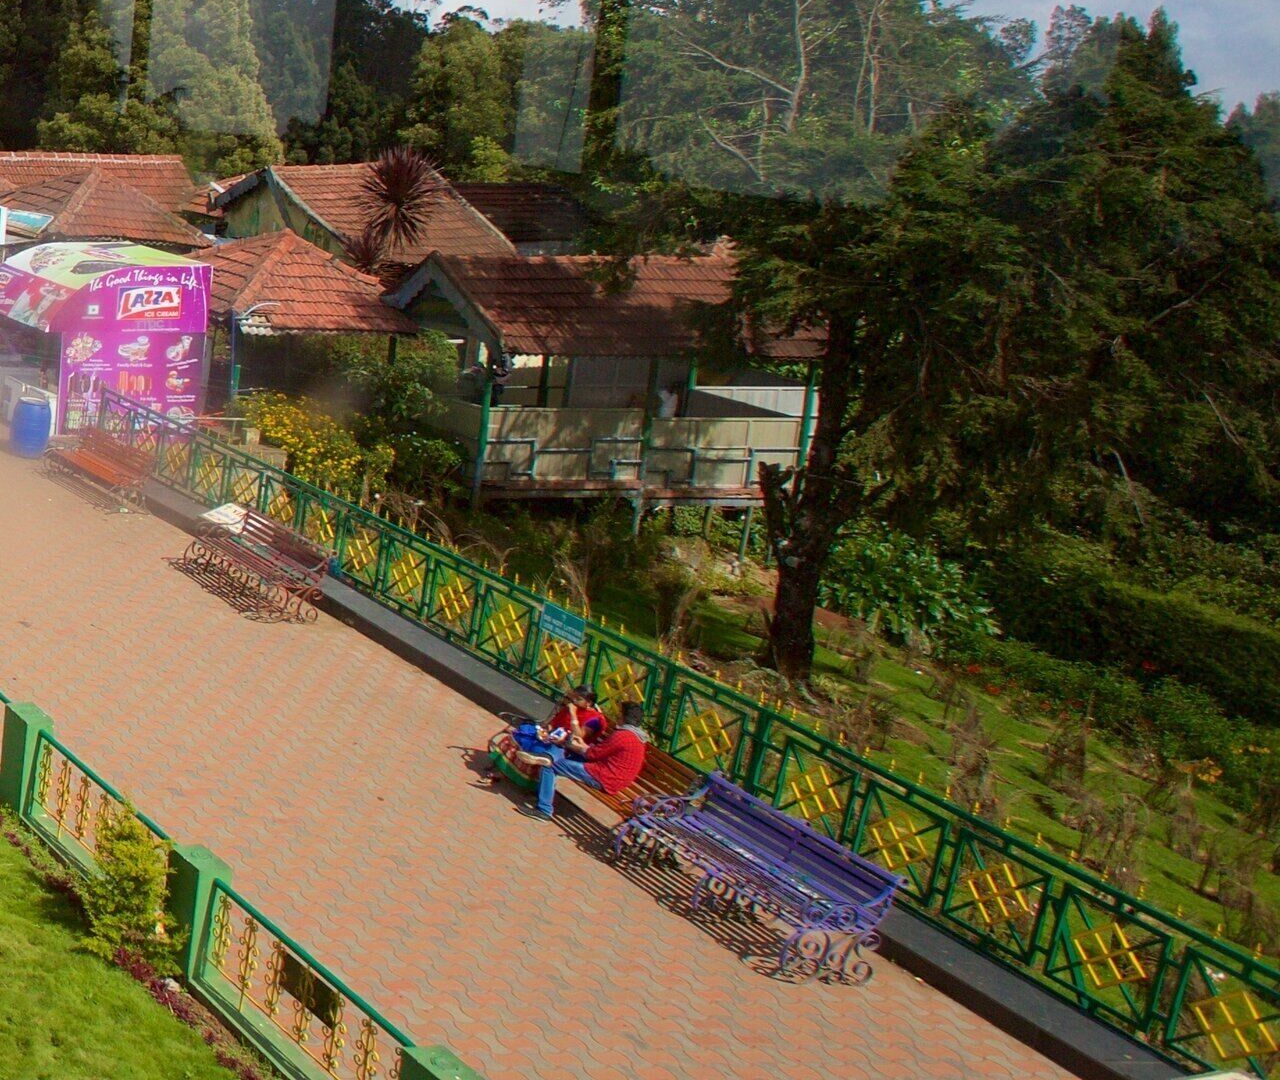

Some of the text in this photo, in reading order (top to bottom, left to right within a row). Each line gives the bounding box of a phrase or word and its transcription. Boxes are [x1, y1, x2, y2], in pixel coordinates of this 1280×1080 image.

[89, 279, 103, 292] The
[106, 271, 132, 287] Good
[133, 269, 164, 286] Things
[166, 272, 178, 283] in
